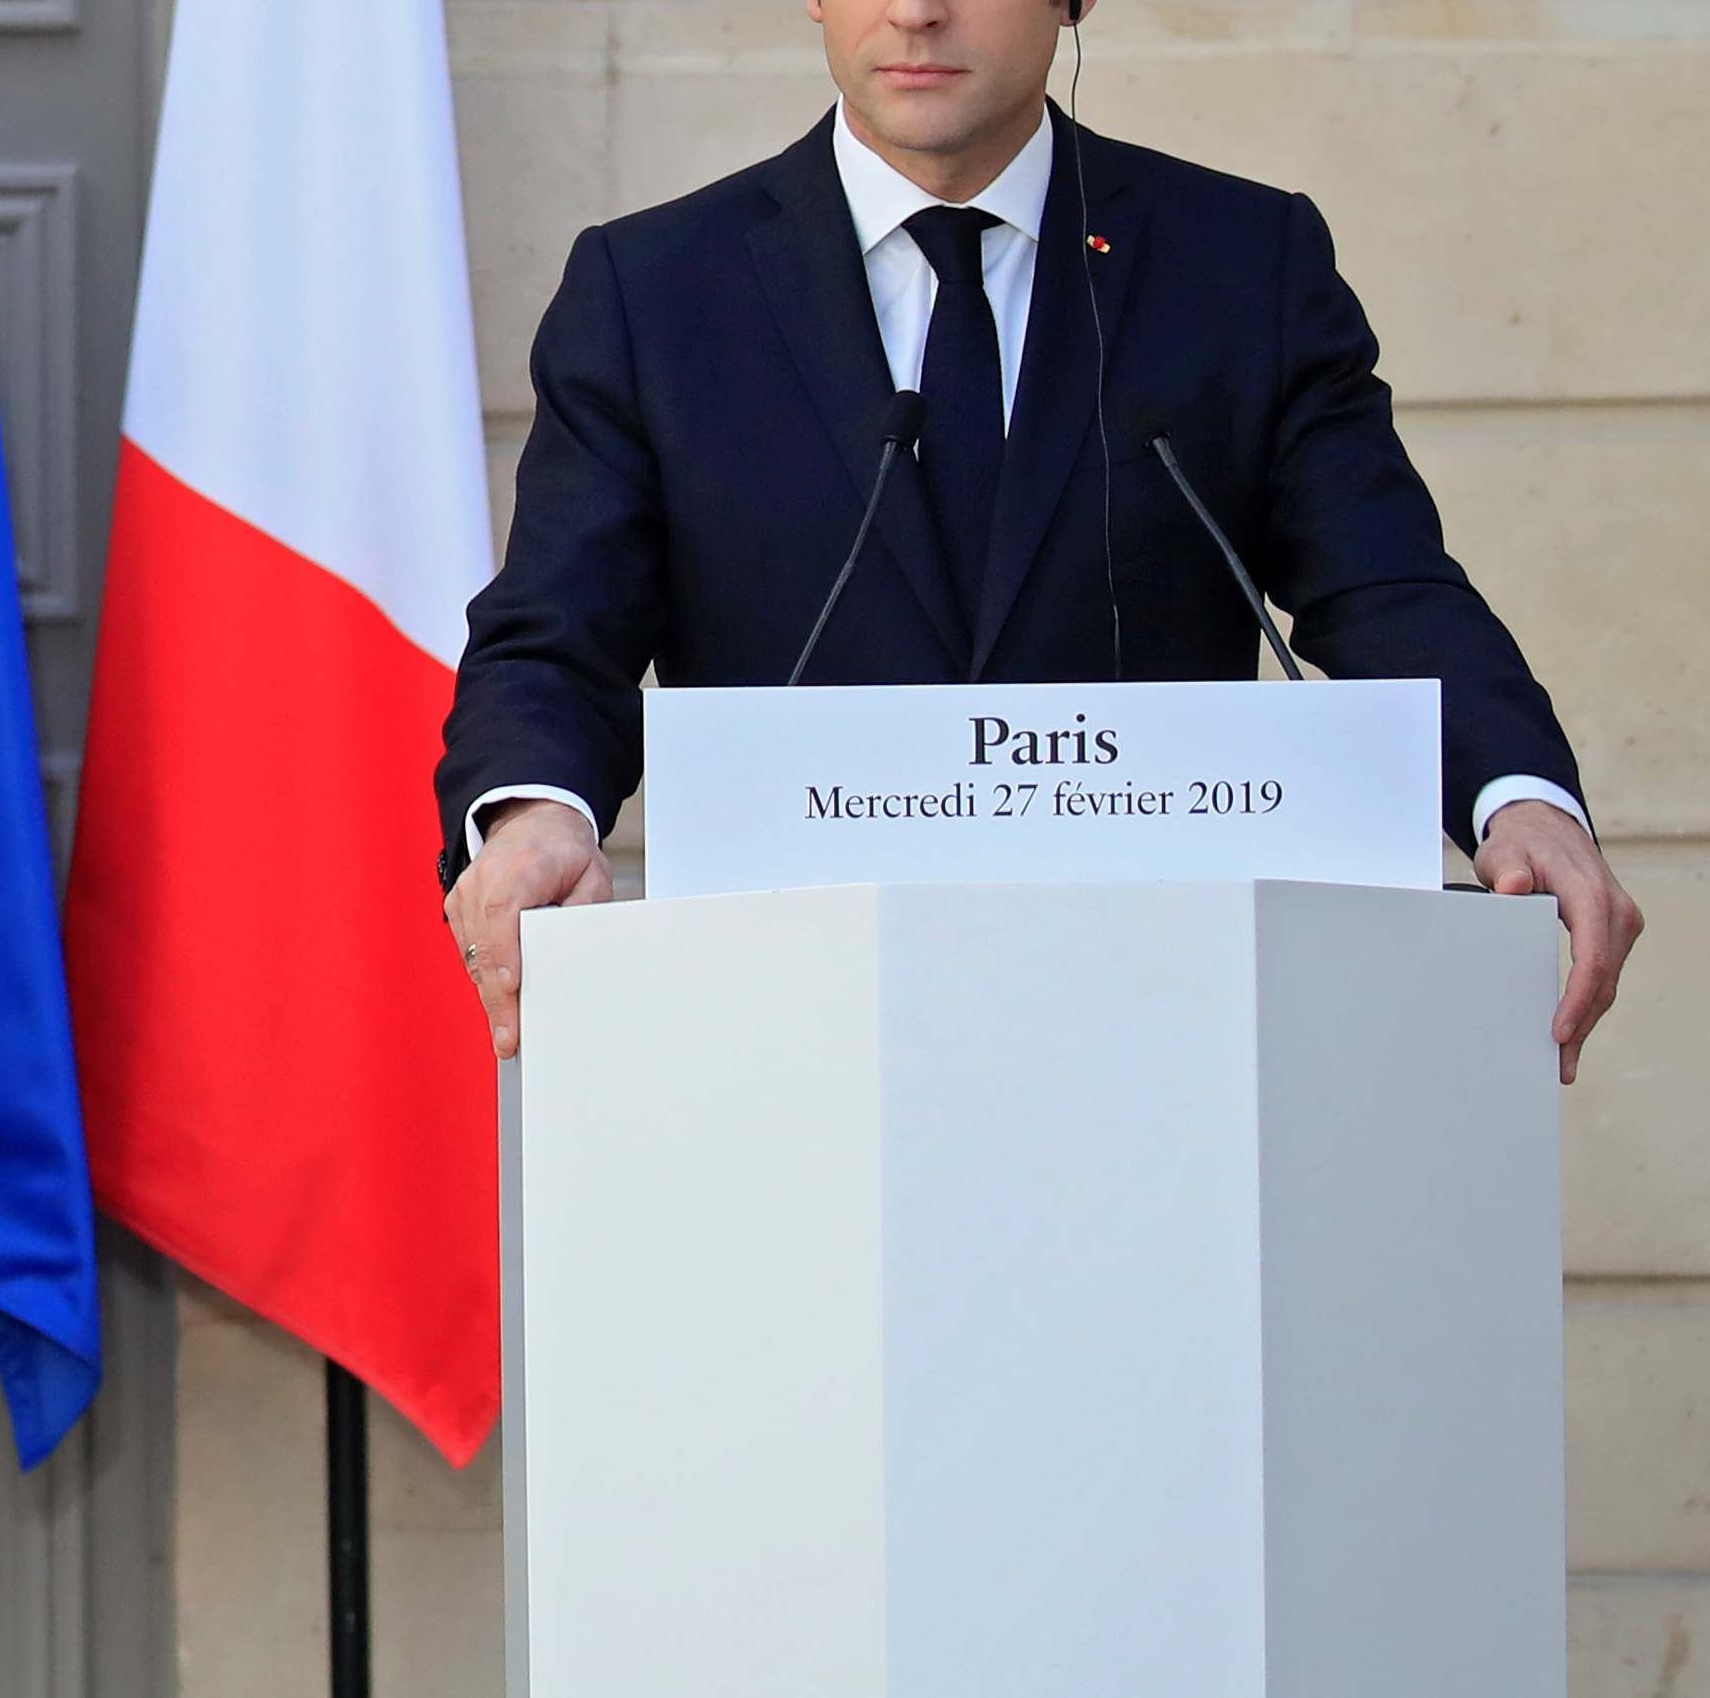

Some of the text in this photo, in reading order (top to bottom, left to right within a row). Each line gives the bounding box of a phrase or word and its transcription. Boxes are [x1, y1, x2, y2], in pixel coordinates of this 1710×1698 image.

[968, 713, 1118, 765] Paris
[804, 780, 1282, 819] Mercredi 27 février 2019
